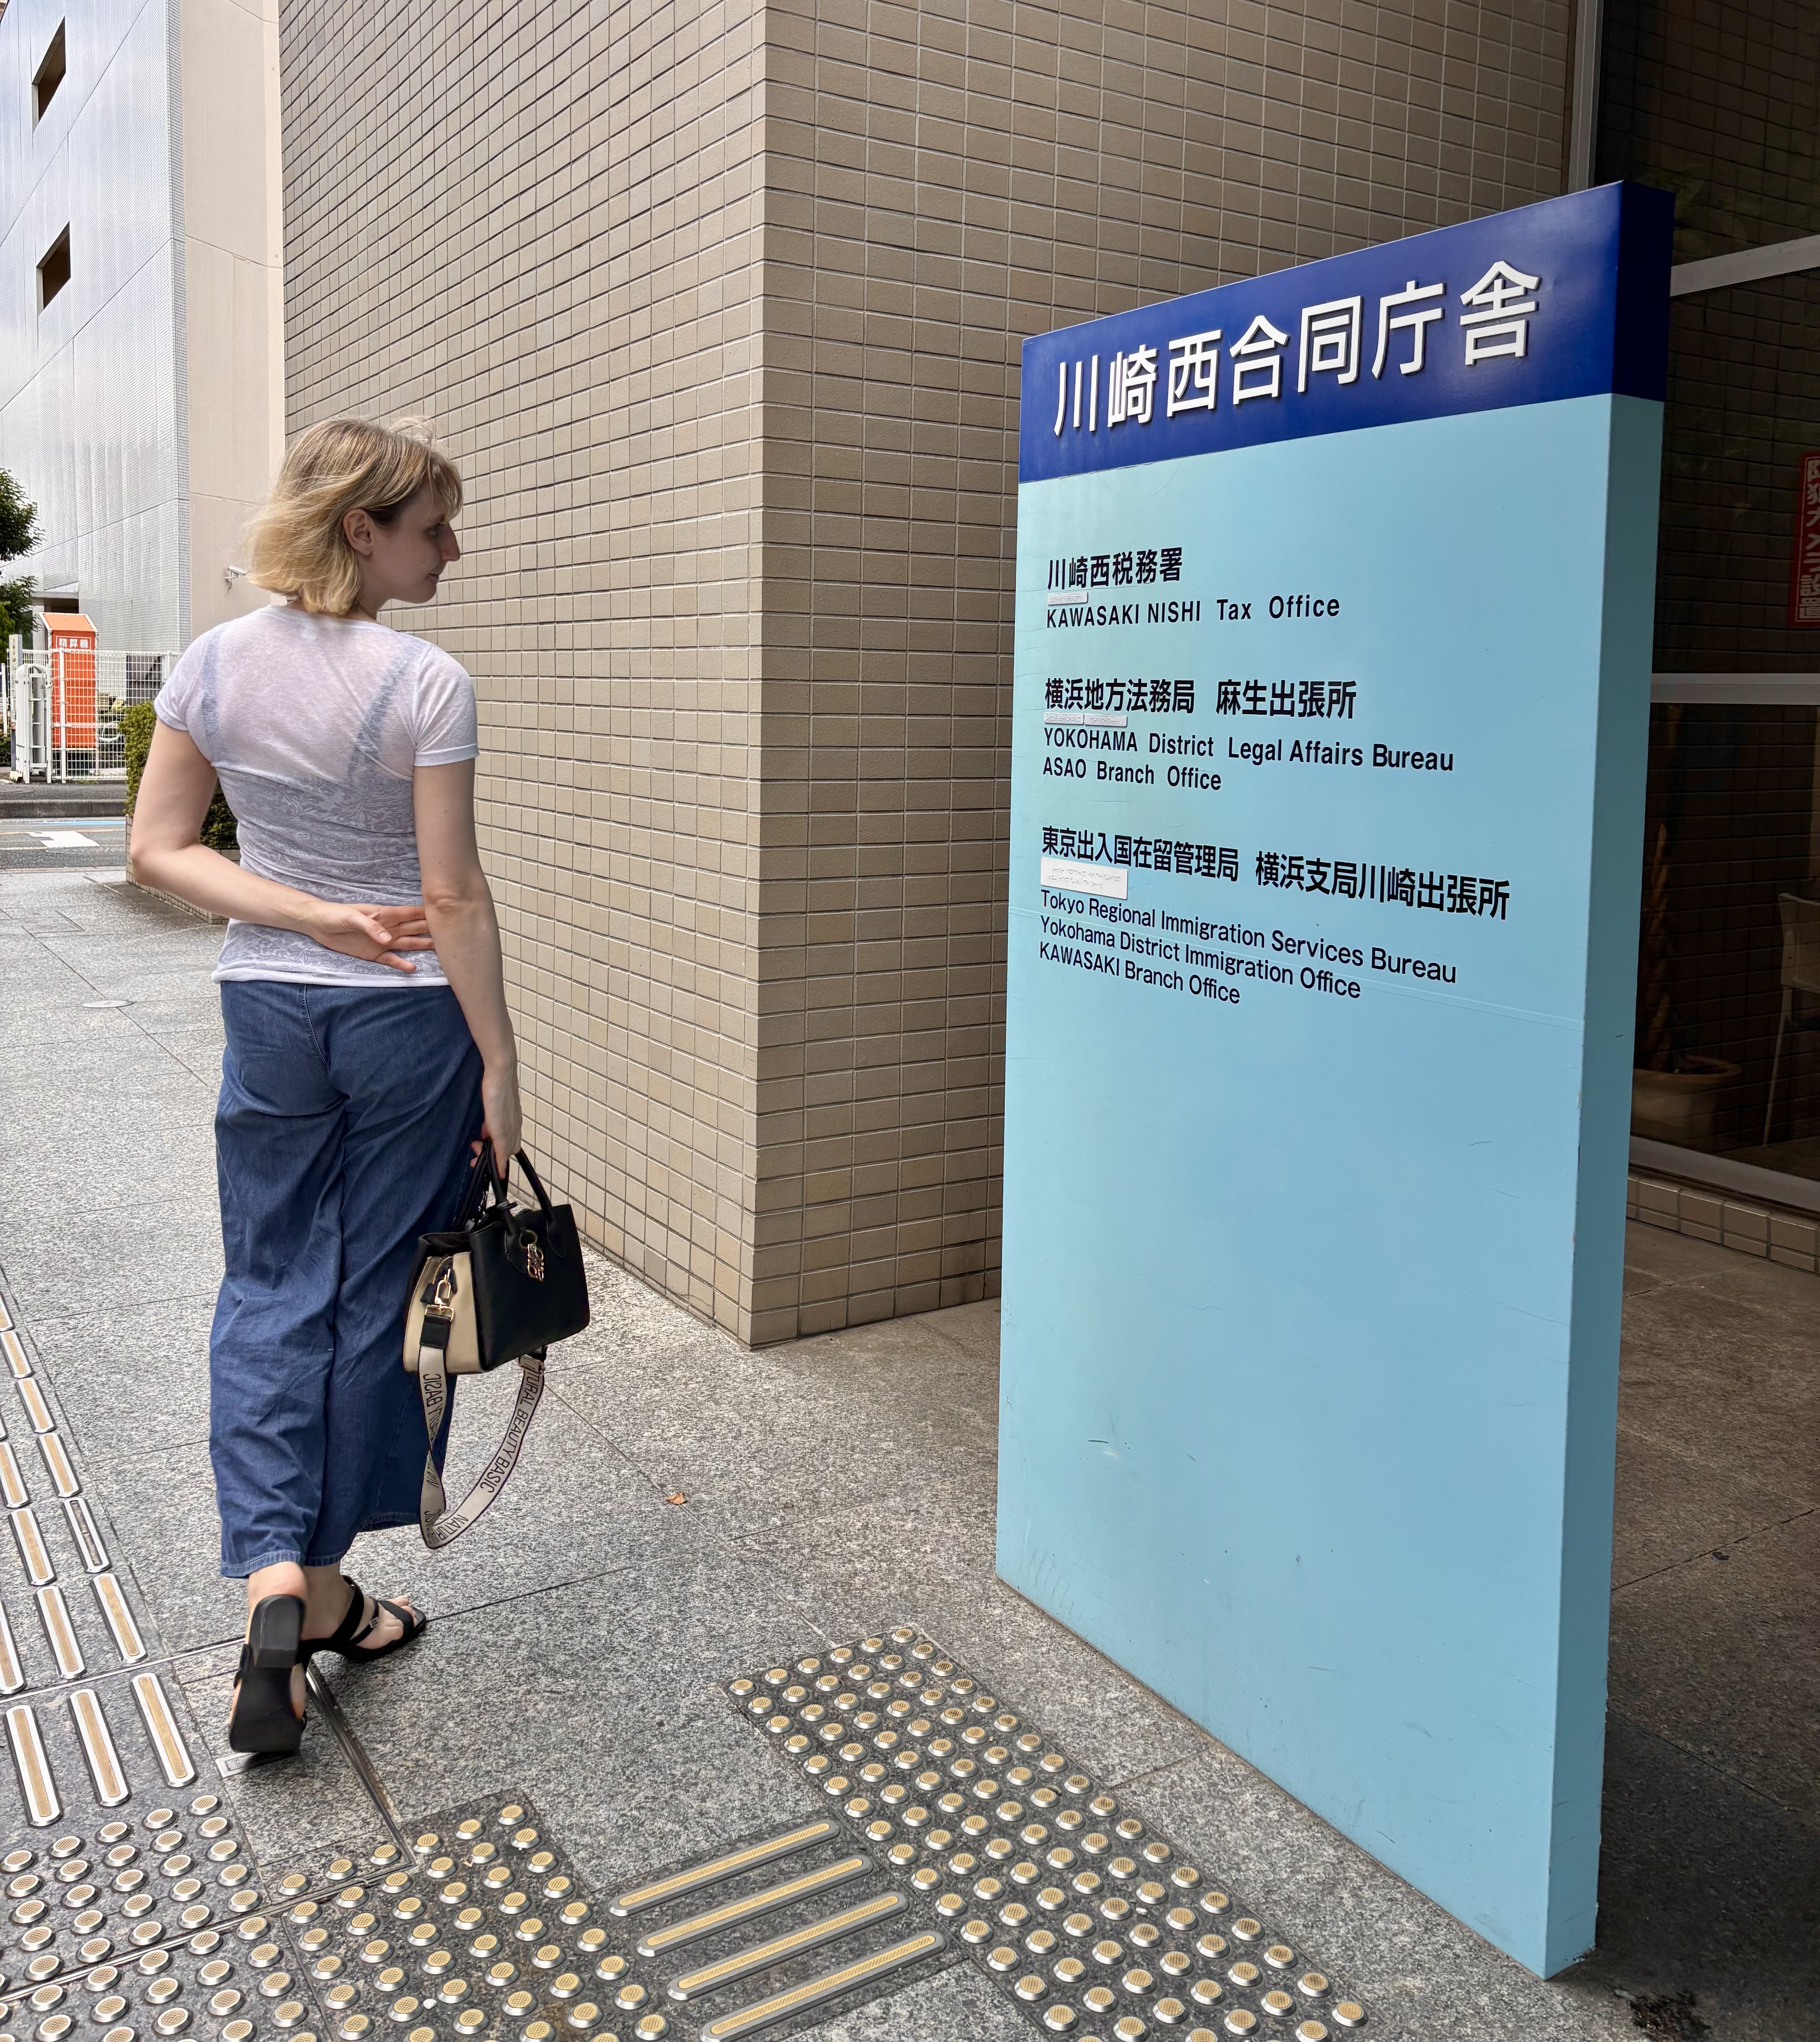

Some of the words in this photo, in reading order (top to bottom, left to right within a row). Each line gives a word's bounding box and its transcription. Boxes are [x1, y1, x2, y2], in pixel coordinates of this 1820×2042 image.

[1053, 260, 1539, 436] 川崎西合同庁舎
[1048, 547, 1182, 590] 川崎西税務署
[1047, 602, 1139, 628] KAWASAKI
[1148, 600, 1200, 623] NISHI
[1216, 599, 1252, 620] Tax
[1269, 594, 1340, 619] Office
[1045, 678, 1195, 714] 横浜地方法務局
[1216, 679, 1357, 719] 麻生出張所
[1044, 727, 1138, 752] YOKOHAMA
[1149, 733, 1214, 757] District
[1229, 737, 1282, 765] Legal
[1289, 740, 1363, 766] Affairs
[1373, 744, 1453, 771] Bureau
[1043, 757, 1086, 778] ASAO
[1097, 761, 1154, 784] Branch
[1167, 765, 1221, 790] Office
[1042, 826, 1239, 882] 東京出入国在留管理局
[1255, 851, 1510, 920] 横浜支局川崎出張所
[1040, 915, 1115, 947] Yokohama
[1120, 931, 1180, 962] District
[1186, 944, 1293, 985] Immigration
[1300, 967, 1361, 998] Office
[1041, 889, 1084, 914] Tokyo
[1089, 898, 1155, 928] Regional
[1162, 910, 1264, 948] Immigration
[1272, 930, 1363, 966] Services
[1371, 947, 1456, 983] Bureau
[1040, 941, 1119, 976] KAWASAKI
[1125, 960, 1183, 991] Branch
[1189, 974, 1240, 1004] Office
[520, 1372, 540, 1406] TURAL
[503, 1409, 528, 1459] BEAUTY
[480, 1456, 510, 1493] BASIC
